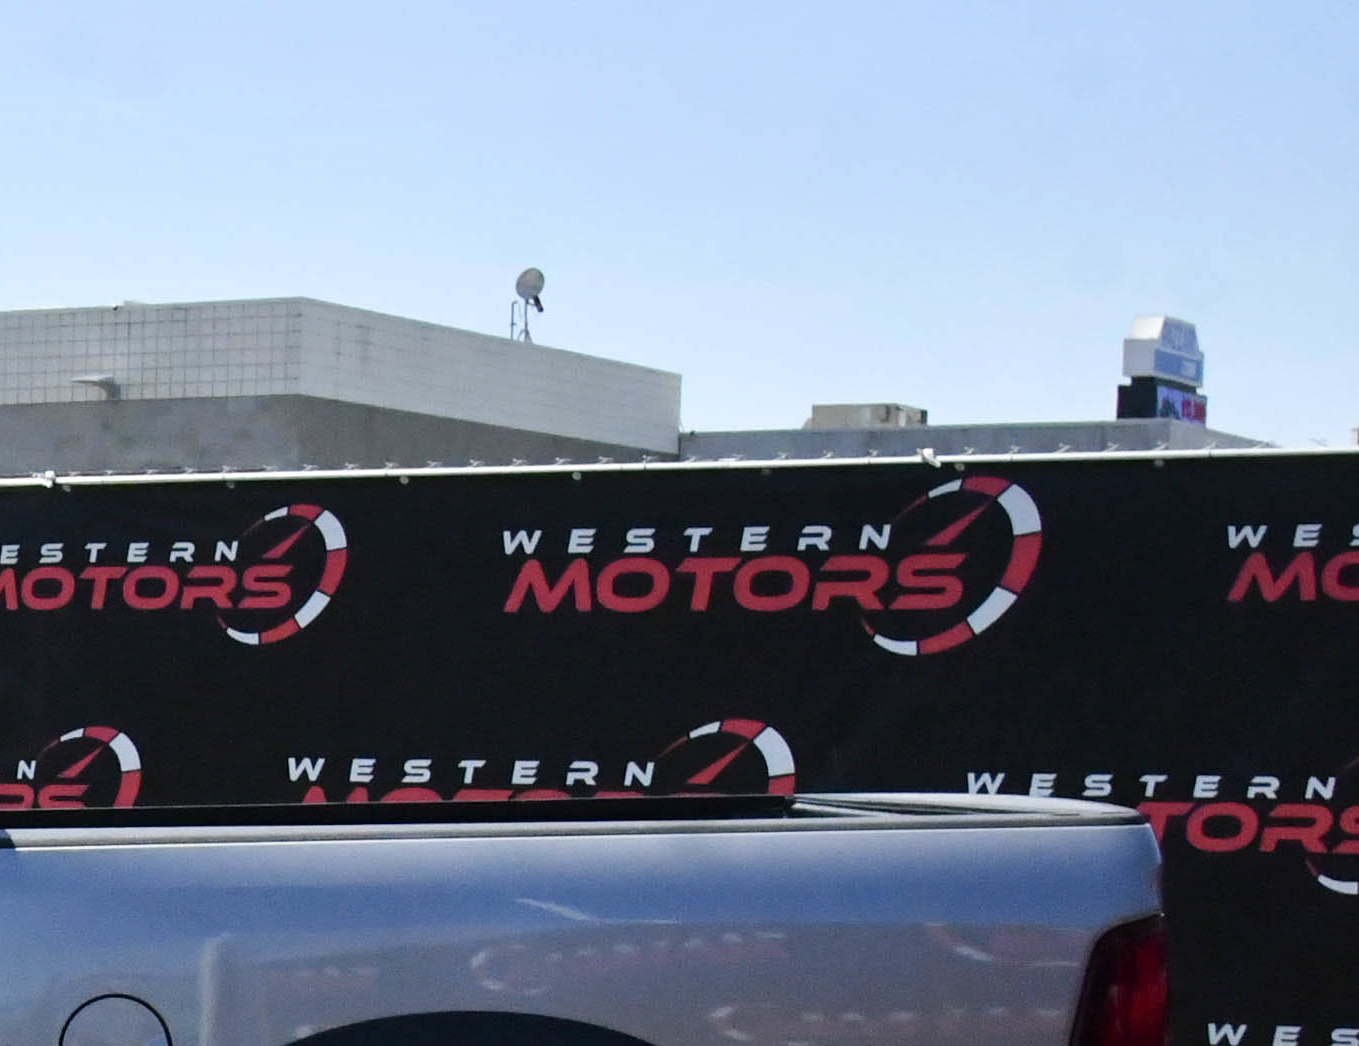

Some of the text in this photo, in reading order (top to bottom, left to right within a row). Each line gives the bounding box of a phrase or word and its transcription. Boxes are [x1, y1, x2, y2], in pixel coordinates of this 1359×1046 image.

[502, 523, 892, 555] WESTERN
[503, 553, 968, 613] MOTORS
[287, 757, 655, 787] WESTERN
[967, 772, 1336, 800] WESTERN
